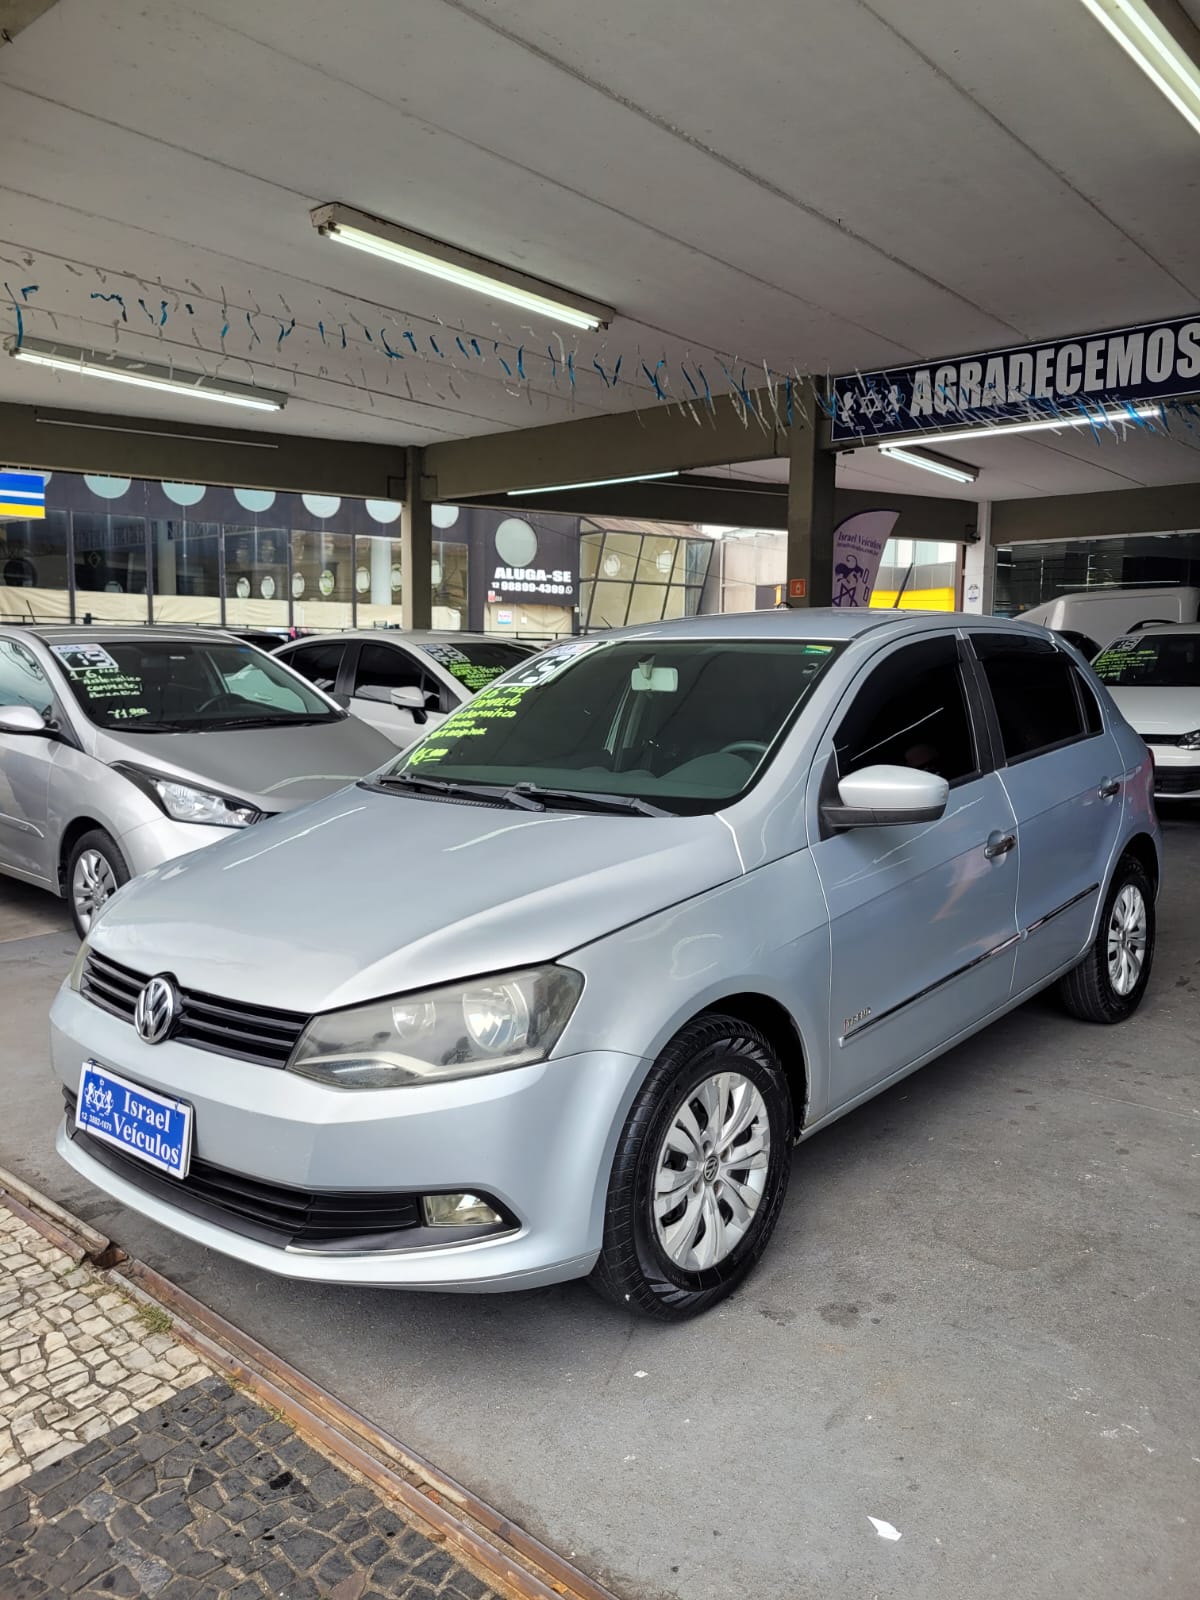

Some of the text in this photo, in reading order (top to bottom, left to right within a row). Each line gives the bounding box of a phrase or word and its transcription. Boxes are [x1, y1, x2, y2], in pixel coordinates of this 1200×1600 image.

[909, 322, 1200, 418] AGRADECEMOS
[494, 567, 572, 583] ALUGA-SE
[123, 1090, 171, 1133] Israel
[112, 1111, 179, 1165] Veículos
